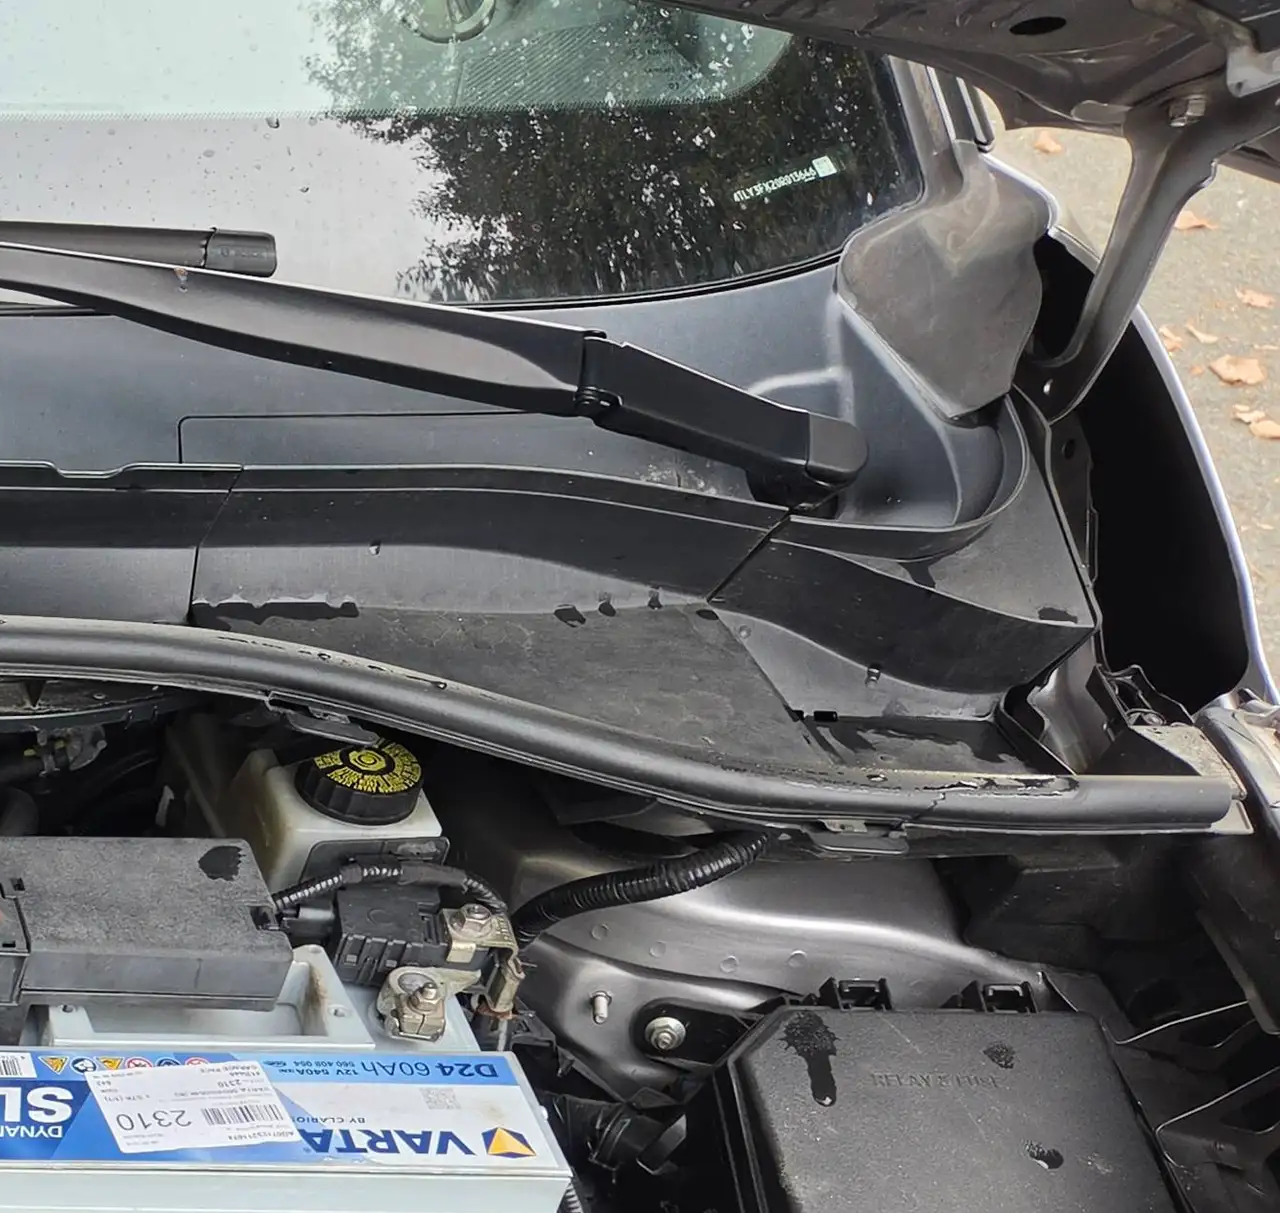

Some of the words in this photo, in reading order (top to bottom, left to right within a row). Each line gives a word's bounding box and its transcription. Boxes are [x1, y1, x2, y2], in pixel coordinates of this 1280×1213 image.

[336, 1068, 359, 1076] 12V
[361, 1061, 429, 1078] 60Ah
[437, 1063, 498, 1078] D24
[115, 1108, 193, 1133] 2310
[349, 1116, 366, 1124] BY
[297, 1127, 476, 1157] VARTA
